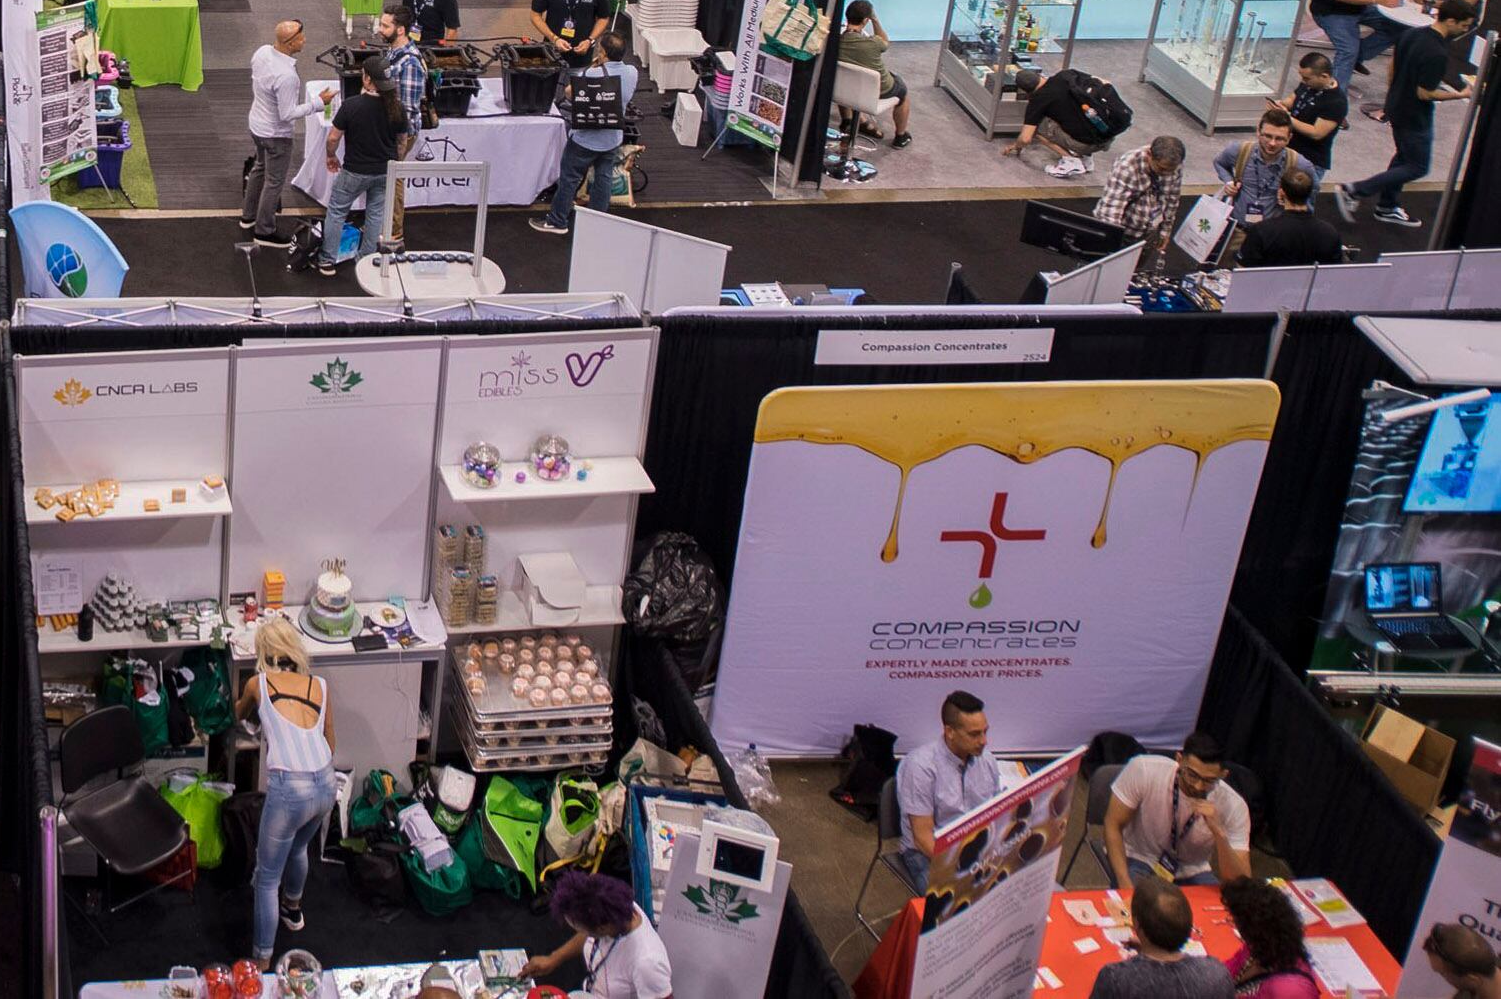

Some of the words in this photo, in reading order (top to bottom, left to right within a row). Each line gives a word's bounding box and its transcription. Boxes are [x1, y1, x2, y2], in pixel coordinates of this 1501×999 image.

[744, 34, 753, 48] All
[739, 49, 750, 74] With
[734, 77, 746, 108] Works
[862, 341, 932, 353] Compassion
[934, 340, 1008, 352] Concentrates
[1023, 353, 1047, 361] 2524
[479, 365, 558, 389] miss
[96, 384, 145, 397] CNCA
[478, 386, 523, 398] EDIBLES
[871, 620, 1081, 635] COMPASSION
[869, 635, 1078, 651] concentrates
[866, 659, 928, 669] EXPERTLY
[930, 658, 964, 668] MADE
[966, 657, 1072, 668] CONCENTRATES.
[888, 669, 995, 680] COMPASSIONATE
[998, 668, 1045, 678] PRICES.
[1470, 799, 1499, 820] Fly
